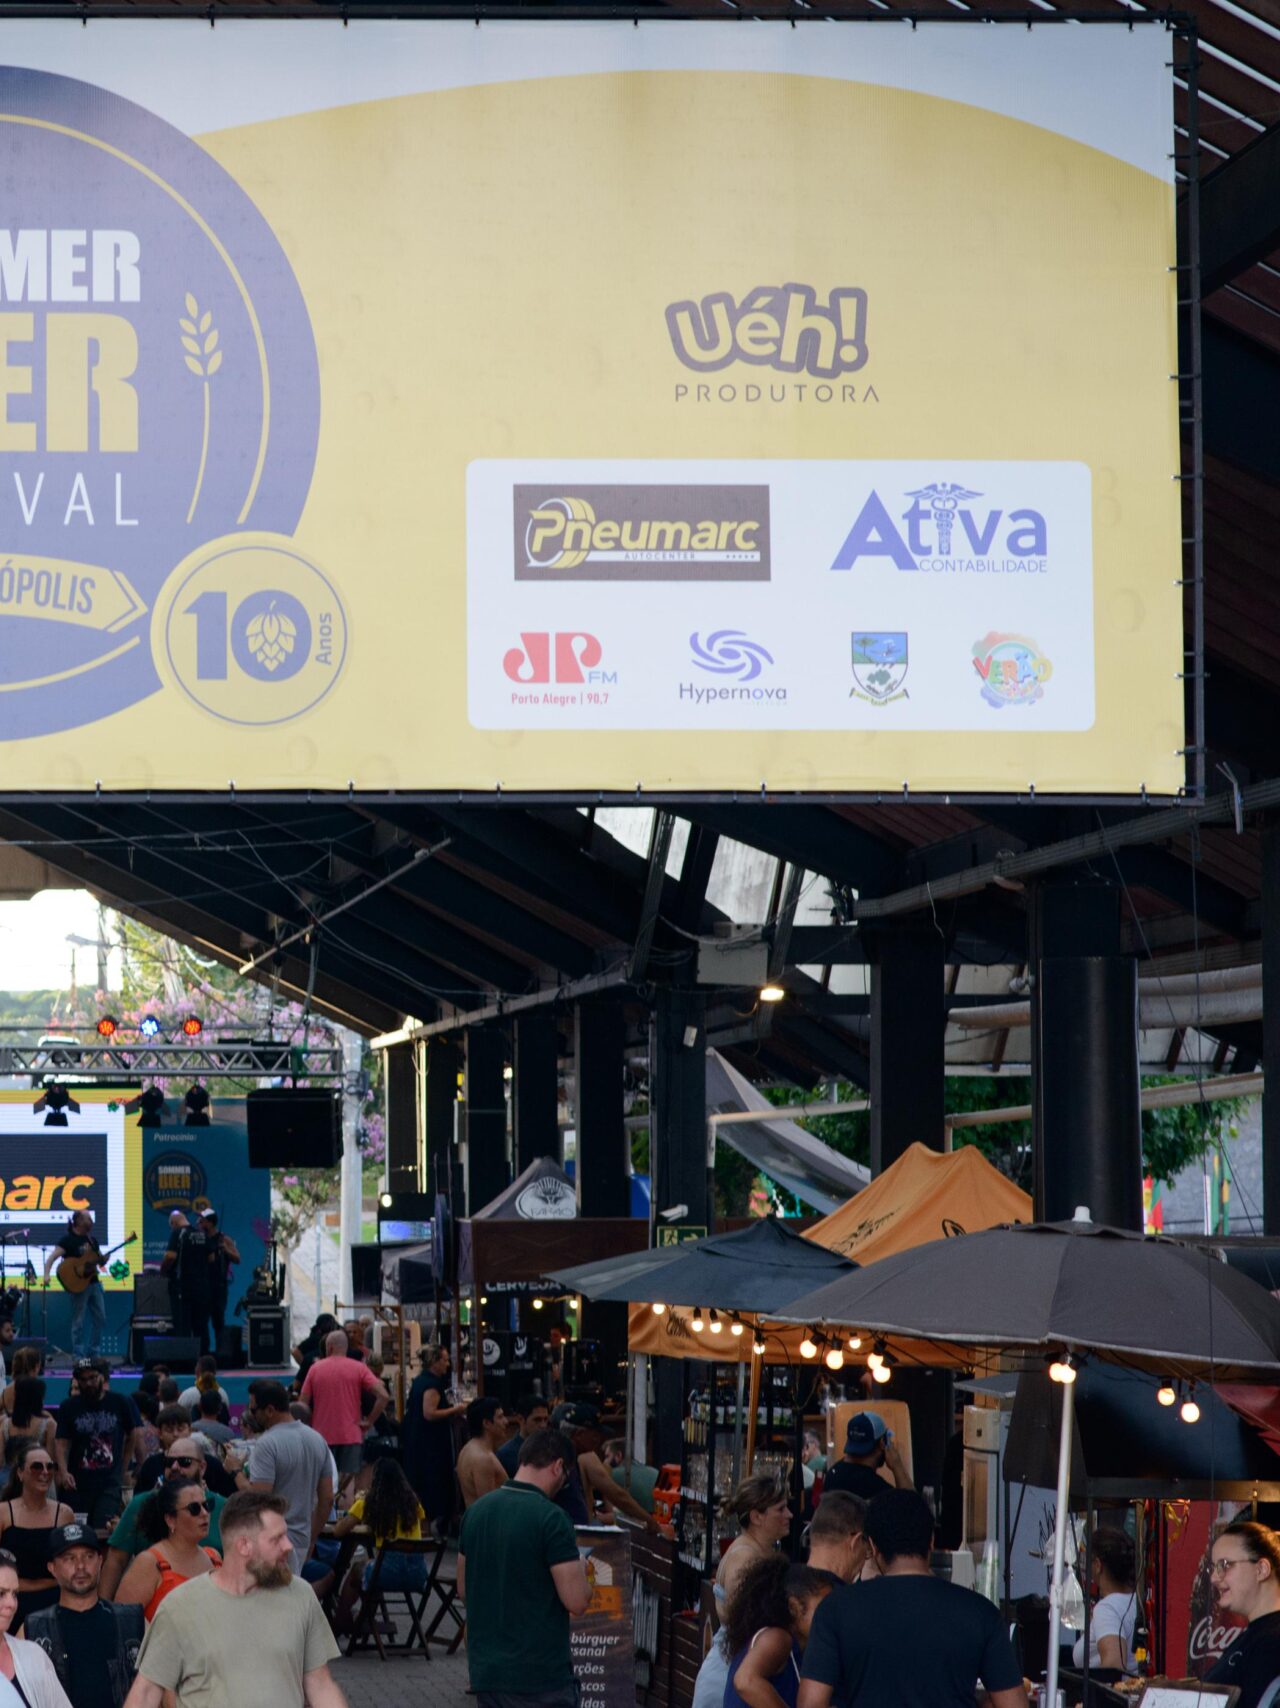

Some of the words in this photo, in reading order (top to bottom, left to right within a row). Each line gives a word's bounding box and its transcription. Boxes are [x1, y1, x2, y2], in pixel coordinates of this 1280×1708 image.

[665, 282, 870, 380] Uéh!
[675, 384, 880, 403] PRODUTORA
[830, 483, 1048, 571] Ativa
[526, 510, 761, 560] Pneumarc
[624, 552, 697, 561] AUTOCENTER
[919, 558, 1048, 573] CONTABILIDADE
[182, 588, 313, 682] 10
[315, 611, 333, 666] Anos
[587, 671, 618, 684] FM
[511, 692, 540, 705] Porto
[542, 692, 577, 708] Alegre
[679, 682, 787, 705] Hypernova
[485, 1281, 569, 1292] CERVEJA
[571, 1632, 620, 1647] búrguer
[573, 1663, 605, 1676] rções
[580, 1682, 606, 1692] scos
[580, 1697, 606, 1708] idas
